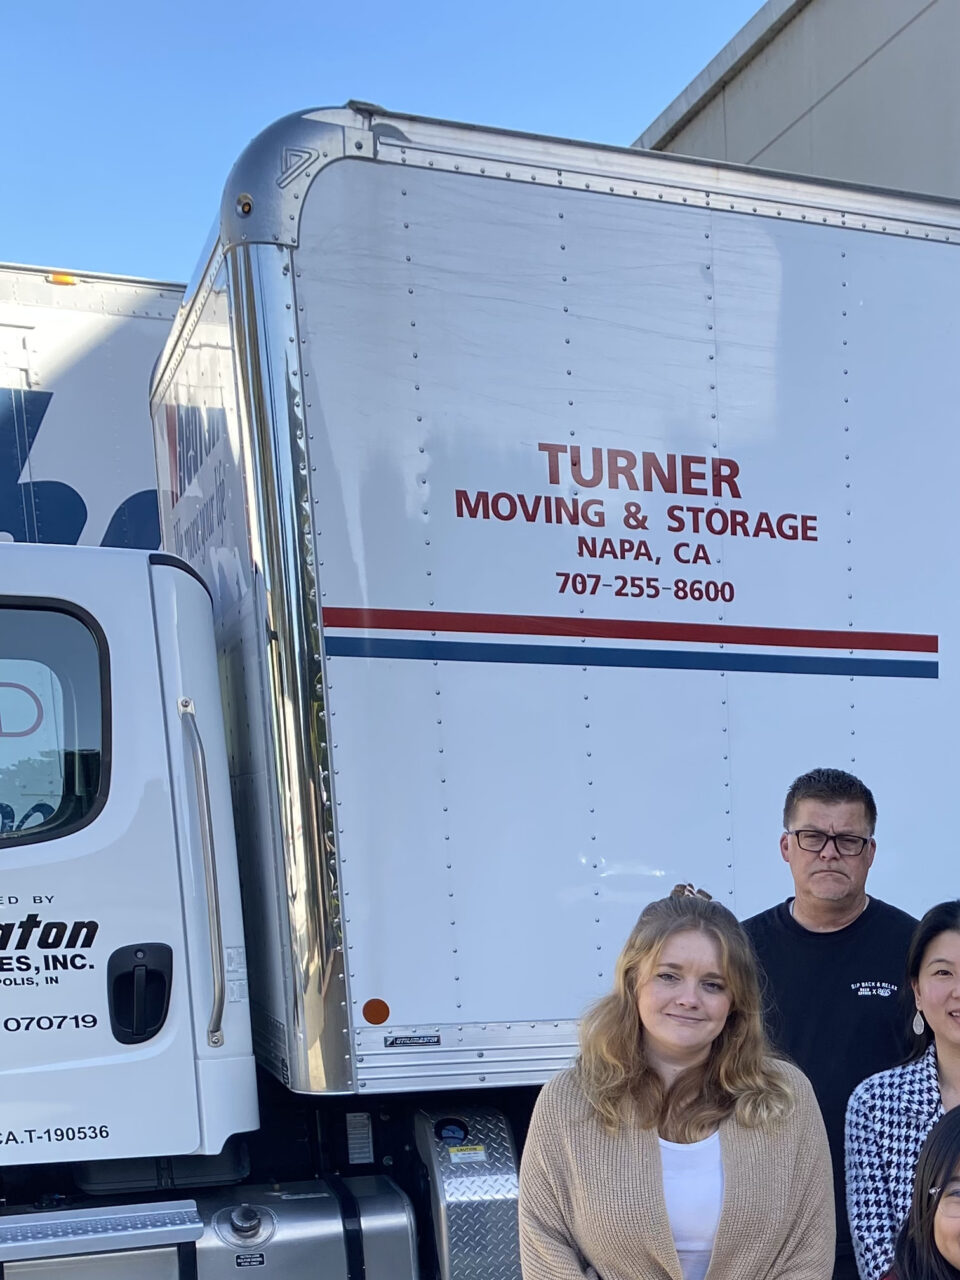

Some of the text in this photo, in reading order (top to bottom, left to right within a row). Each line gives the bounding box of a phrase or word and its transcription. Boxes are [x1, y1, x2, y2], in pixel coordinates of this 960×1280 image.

[538, 442, 742, 499] TURNER
[455, 489, 818, 542] MOVING & STORAGE
[577, 536, 712, 565] NAPA, CA
[556, 572, 736, 602] 707-255-8600
[33, 896, 54, 904] BY
[45, 976, 59, 985] IN
[3, 1014, 98, 1031] 070719
